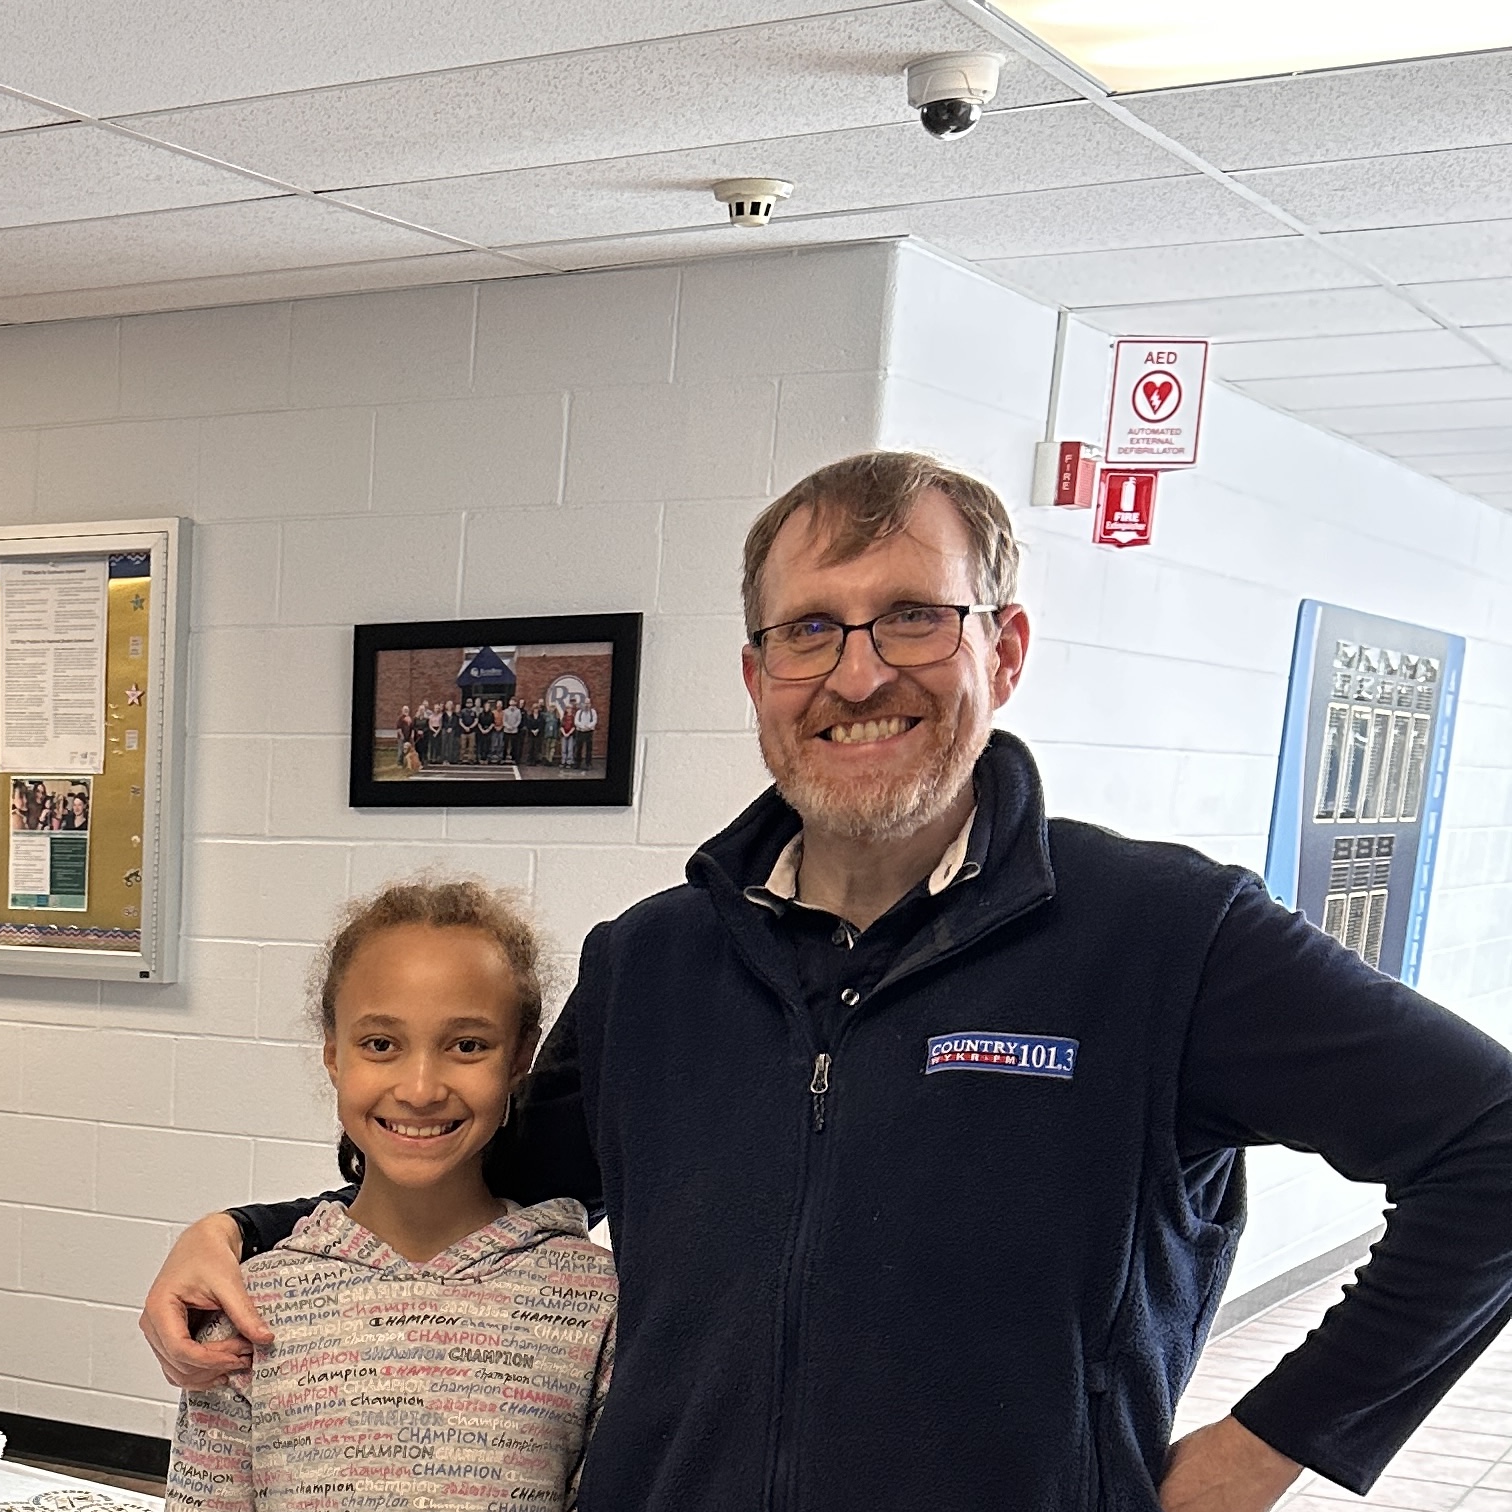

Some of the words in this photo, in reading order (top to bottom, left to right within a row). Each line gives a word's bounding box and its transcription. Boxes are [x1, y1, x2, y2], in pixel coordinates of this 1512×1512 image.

[1144, 351, 1178, 365] AED
[1127, 427, 1183, 436] AUTOMATED
[1129, 437, 1174, 446] EXTERNAL
[1117, 447, 1185, 455] DEFIBRILLATOR
[1062, 454, 1074, 491] FIRE
[1113, 511, 1141, 523] FIRE
[931, 1040, 1019, 1056] COUNTRY
[1018, 1044, 1074, 1072] 101.3
[530, 1247, 595, 1263] hampion
[514, 1294, 601, 1314] CHAMPION
[269, 1309, 340, 1327] champion
[511, 1310, 591, 1329] CHAMPION
[406, 1329, 501, 1348] CHAMPION
[280, 1350, 360, 1376] CHAMPION
[297, 1366, 378, 1388] champion
[430, 1380, 501, 1399] champion
[350, 1392, 424, 1408] champion
[447, 1413, 519, 1431] champion
[397, 1427, 488, 1446] CHAMPION
[344, 1444, 434, 1460] CHAMPION
[174, 1462, 233, 1485] CHAMPION
[412, 1463, 502, 1480] CHAMPION
